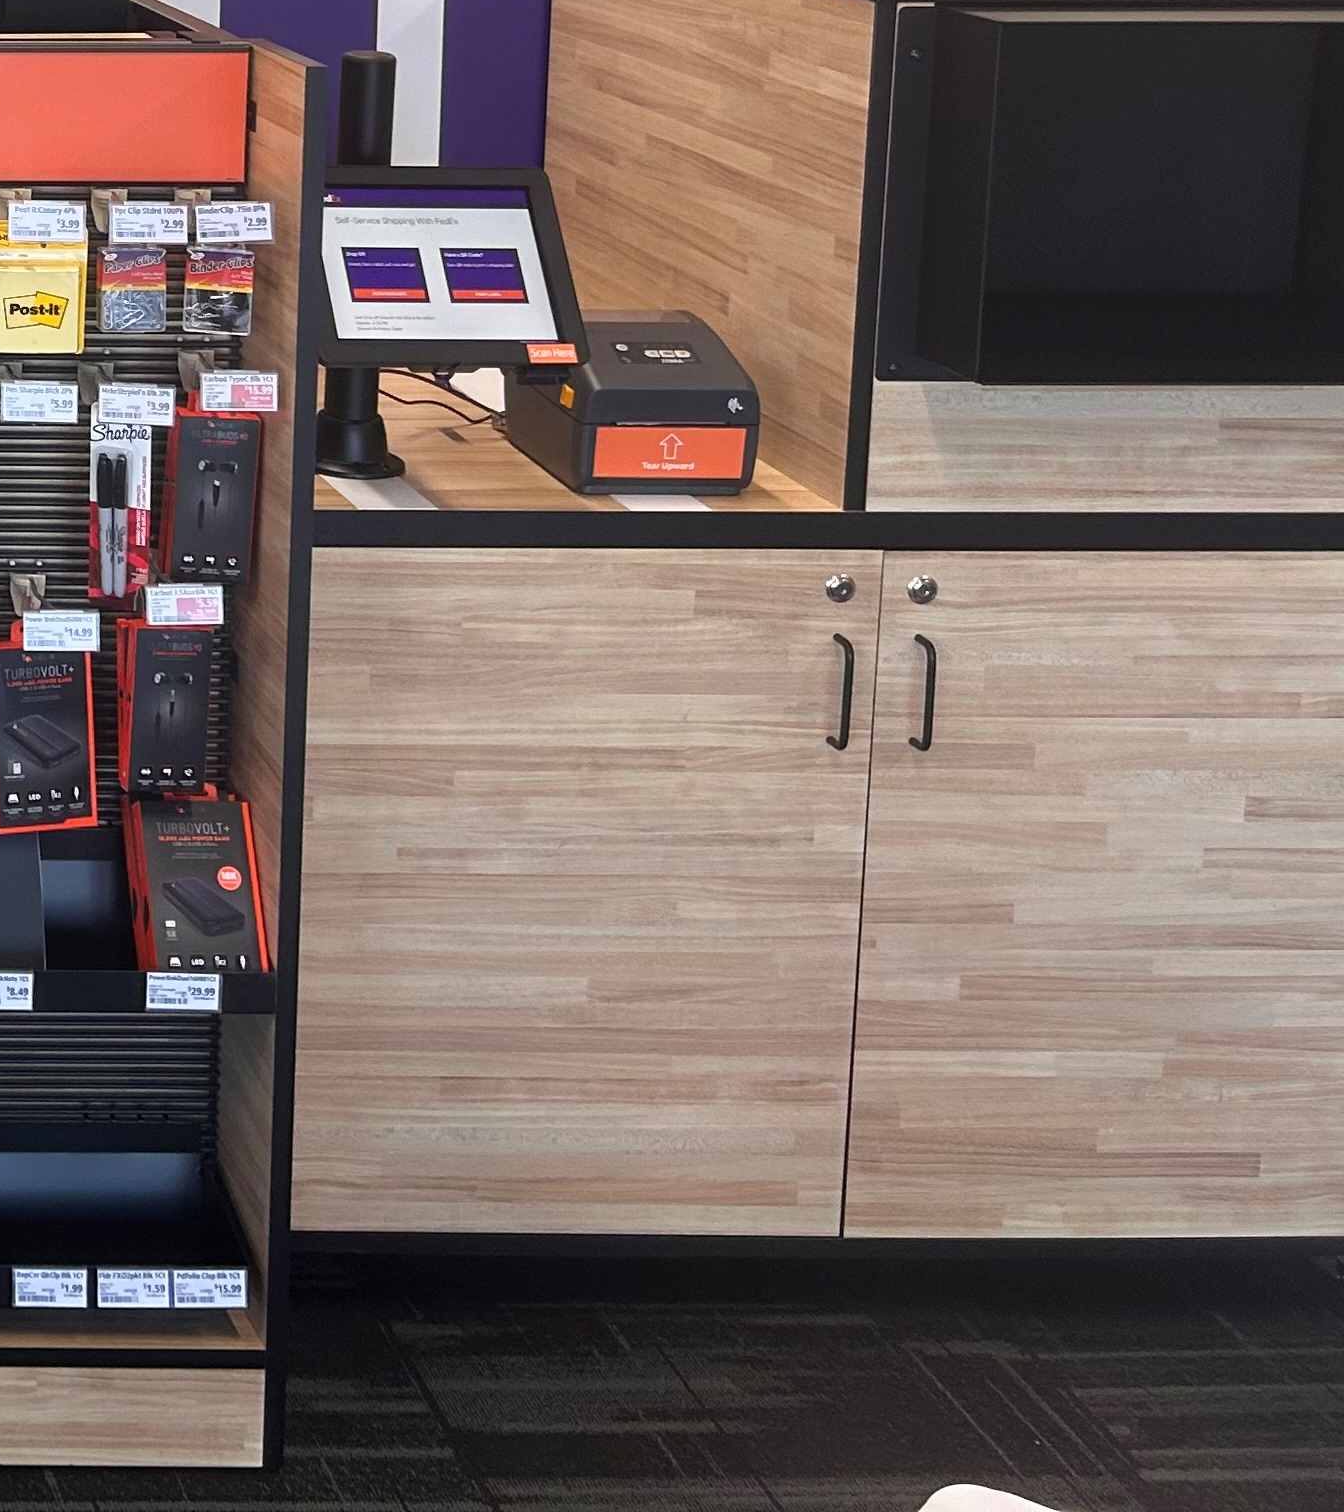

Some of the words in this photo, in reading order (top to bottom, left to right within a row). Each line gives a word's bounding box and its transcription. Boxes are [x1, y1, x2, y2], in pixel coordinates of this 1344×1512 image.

[57, 218, 80, 229] $3.99
[161, 219, 184, 229] $2.99
[244, 216, 267, 227] $2.99
[9, 303, 60, 316] Post-it
[528, 348, 552, 358] Scan
[553, 348, 577, 358] Here
[89, 423, 151, 442] Sharpie
